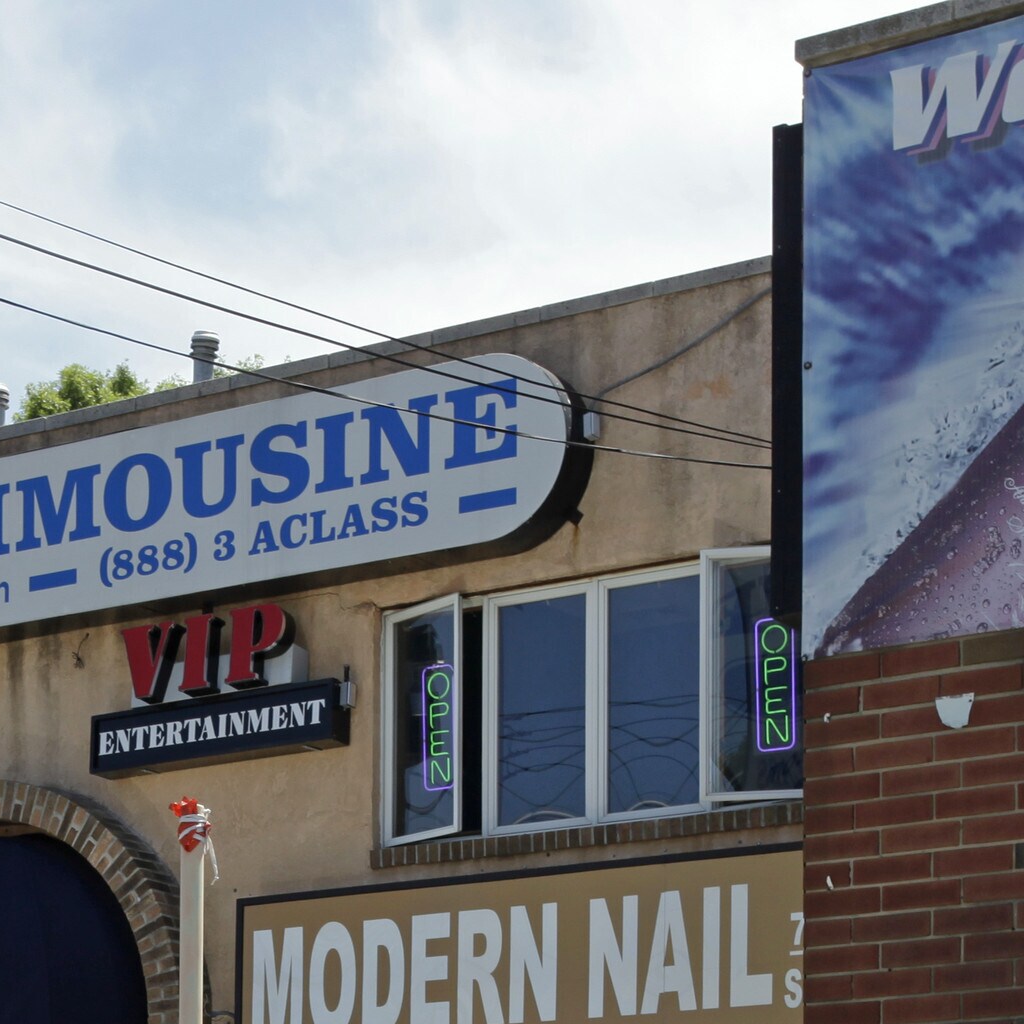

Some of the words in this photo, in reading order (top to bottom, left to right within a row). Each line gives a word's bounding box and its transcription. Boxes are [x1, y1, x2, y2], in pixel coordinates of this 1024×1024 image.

[99, 532, 198, 588] (888)
[213, 530, 236, 561] 3
[248, 491, 429, 555] ACLASS
[122, 603, 289, 701] VIP
[761, 624, 790, 745] OPEN
[98, 699, 326, 757] ENTERTAINMENT
[427, 672, 450, 785] OPEN
[588, 883, 773, 1019] NAIL
